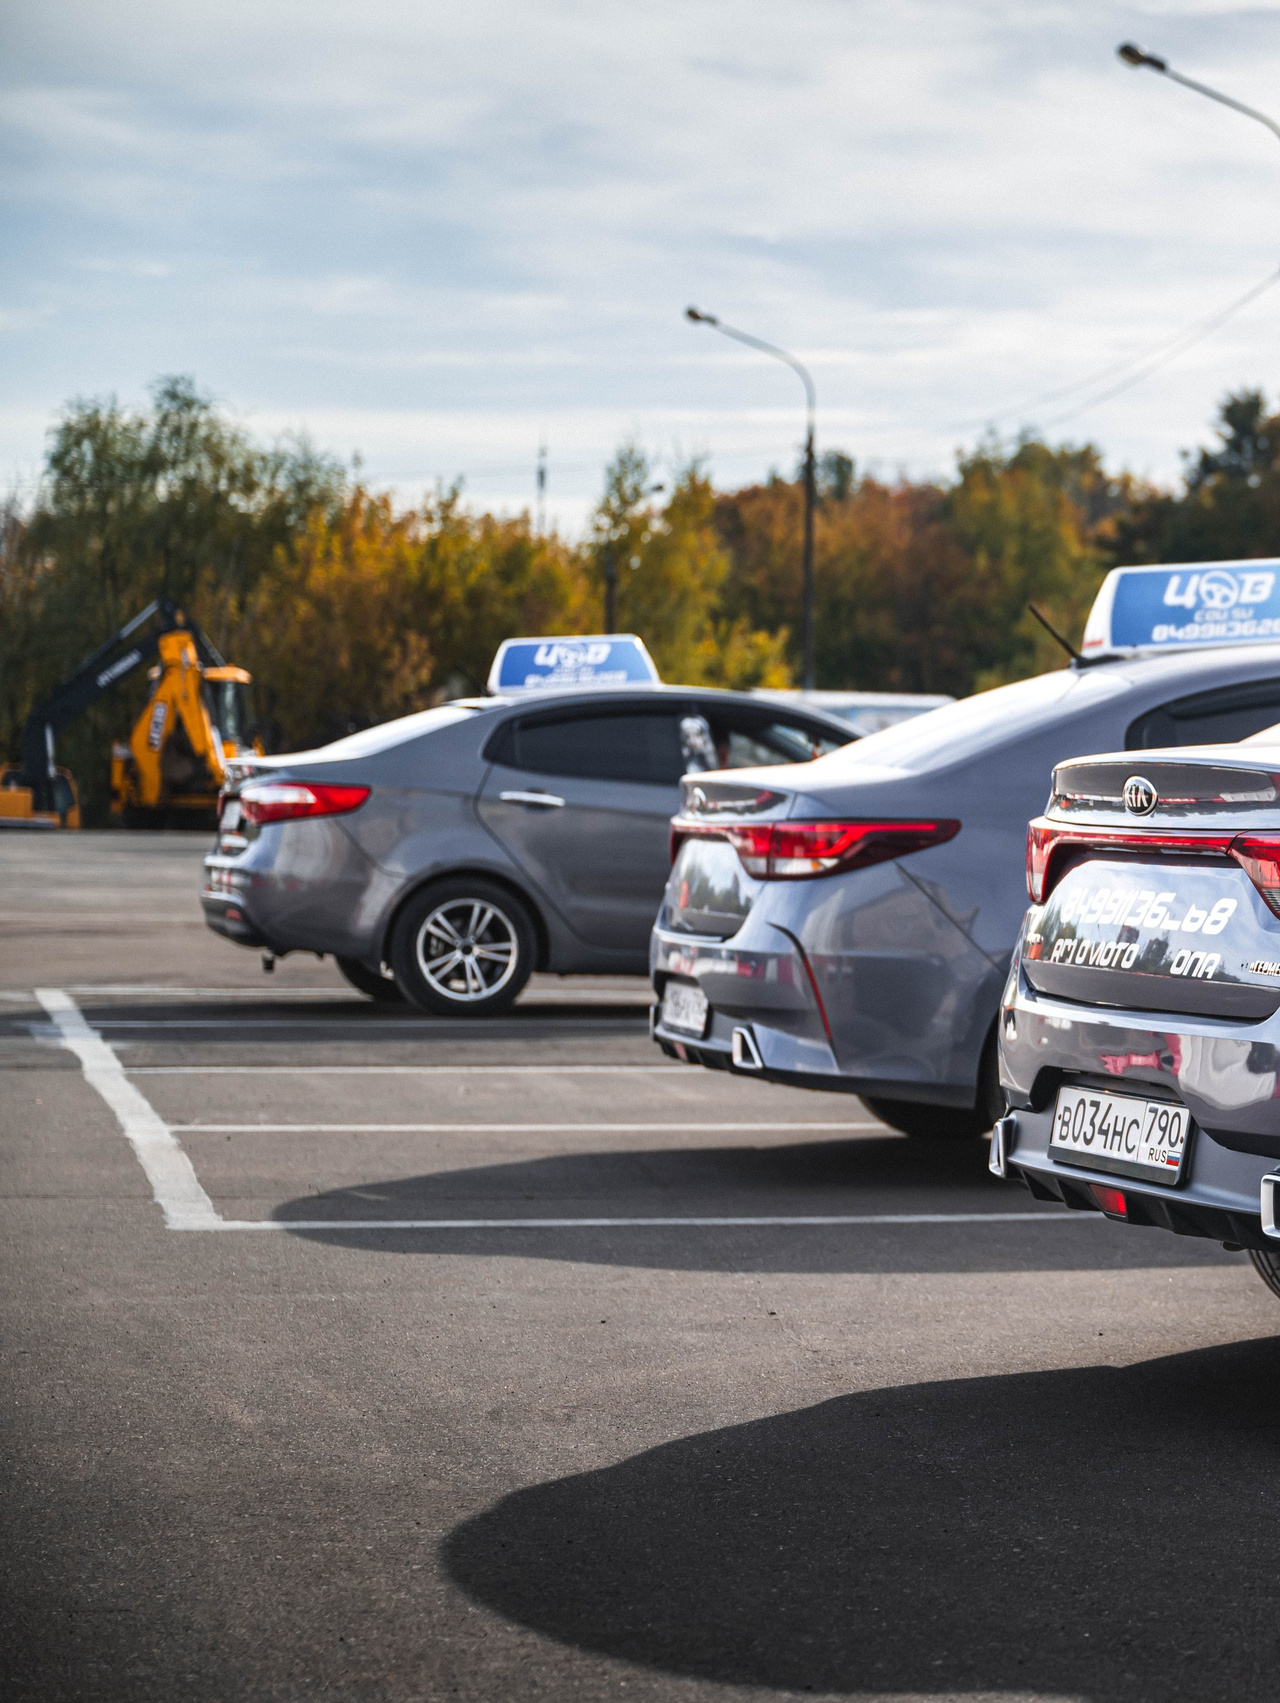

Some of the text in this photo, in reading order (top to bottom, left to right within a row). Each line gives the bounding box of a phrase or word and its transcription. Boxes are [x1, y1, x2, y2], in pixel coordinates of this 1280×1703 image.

[1058, 1097, 1183, 1154] В034НС 790
[1147, 1147, 1168, 1163] RUS
